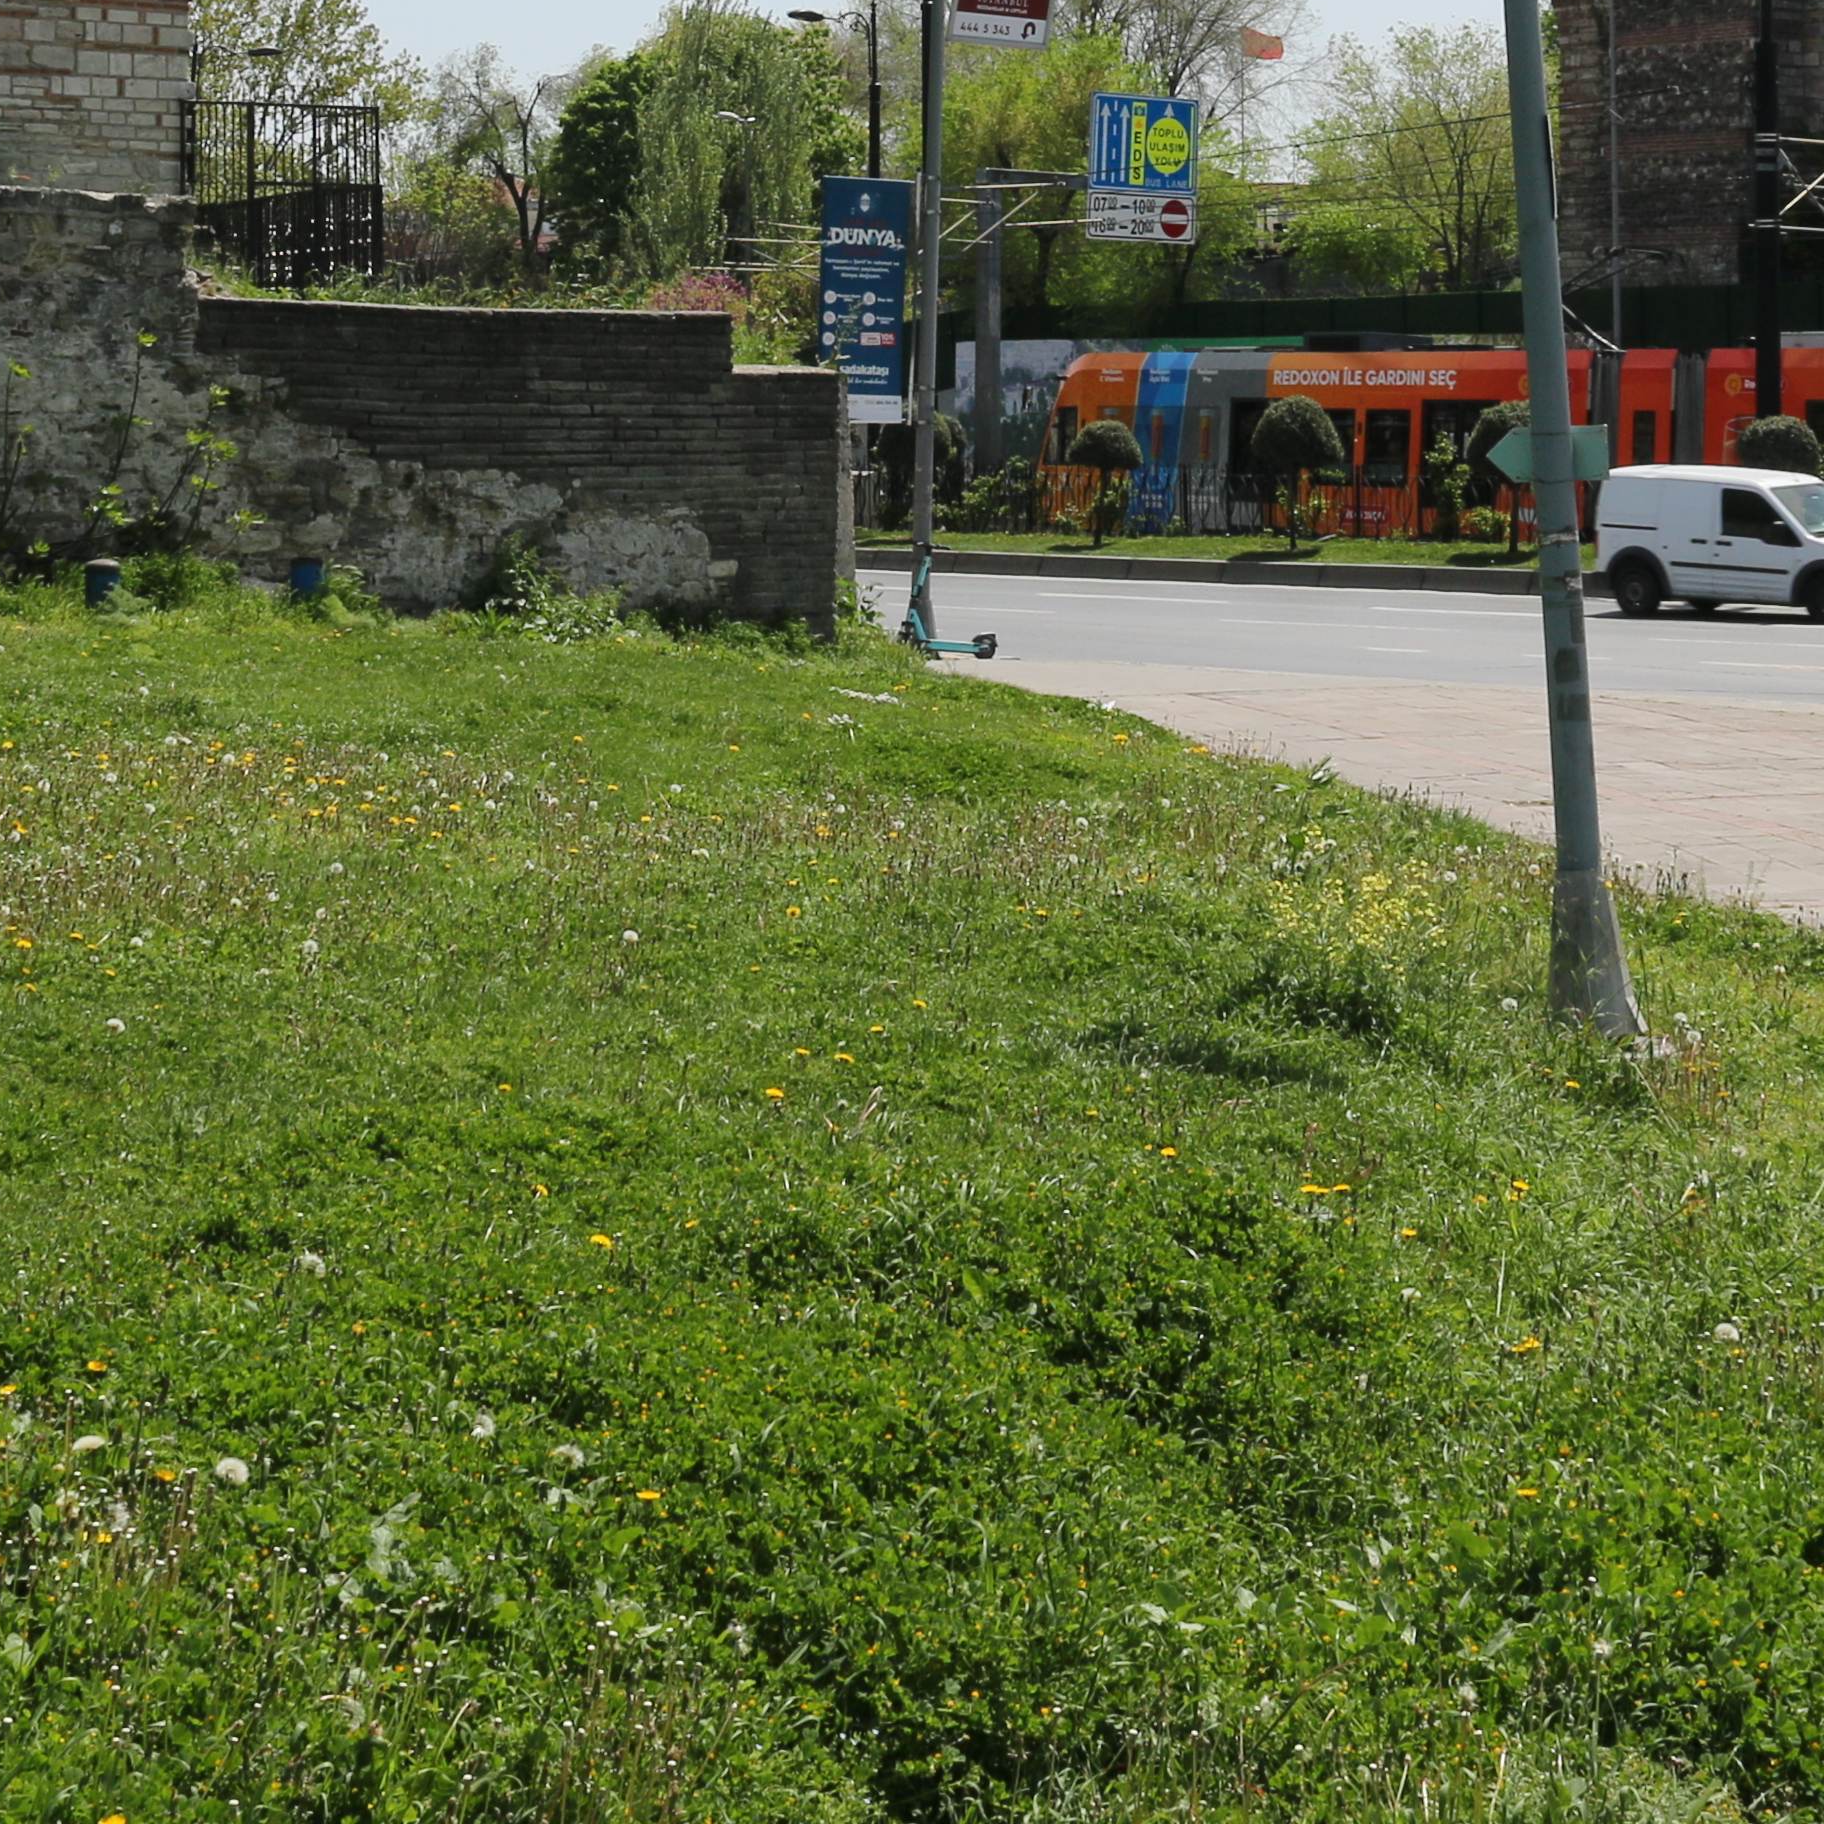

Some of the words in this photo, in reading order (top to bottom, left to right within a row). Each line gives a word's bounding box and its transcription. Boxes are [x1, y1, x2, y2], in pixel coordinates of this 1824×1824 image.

[960, 22, 979, 32] 444
[1153, 128, 1184, 139] TOPLU
[1149, 142, 1185, 154] ULAŞIM
[1273, 370, 1340, 386] REDOXON
[1343, 366, 1362, 386] İLE
[1365, 370, 1425, 386] GARDINI
[1428, 370, 1457, 390] SEÇ
